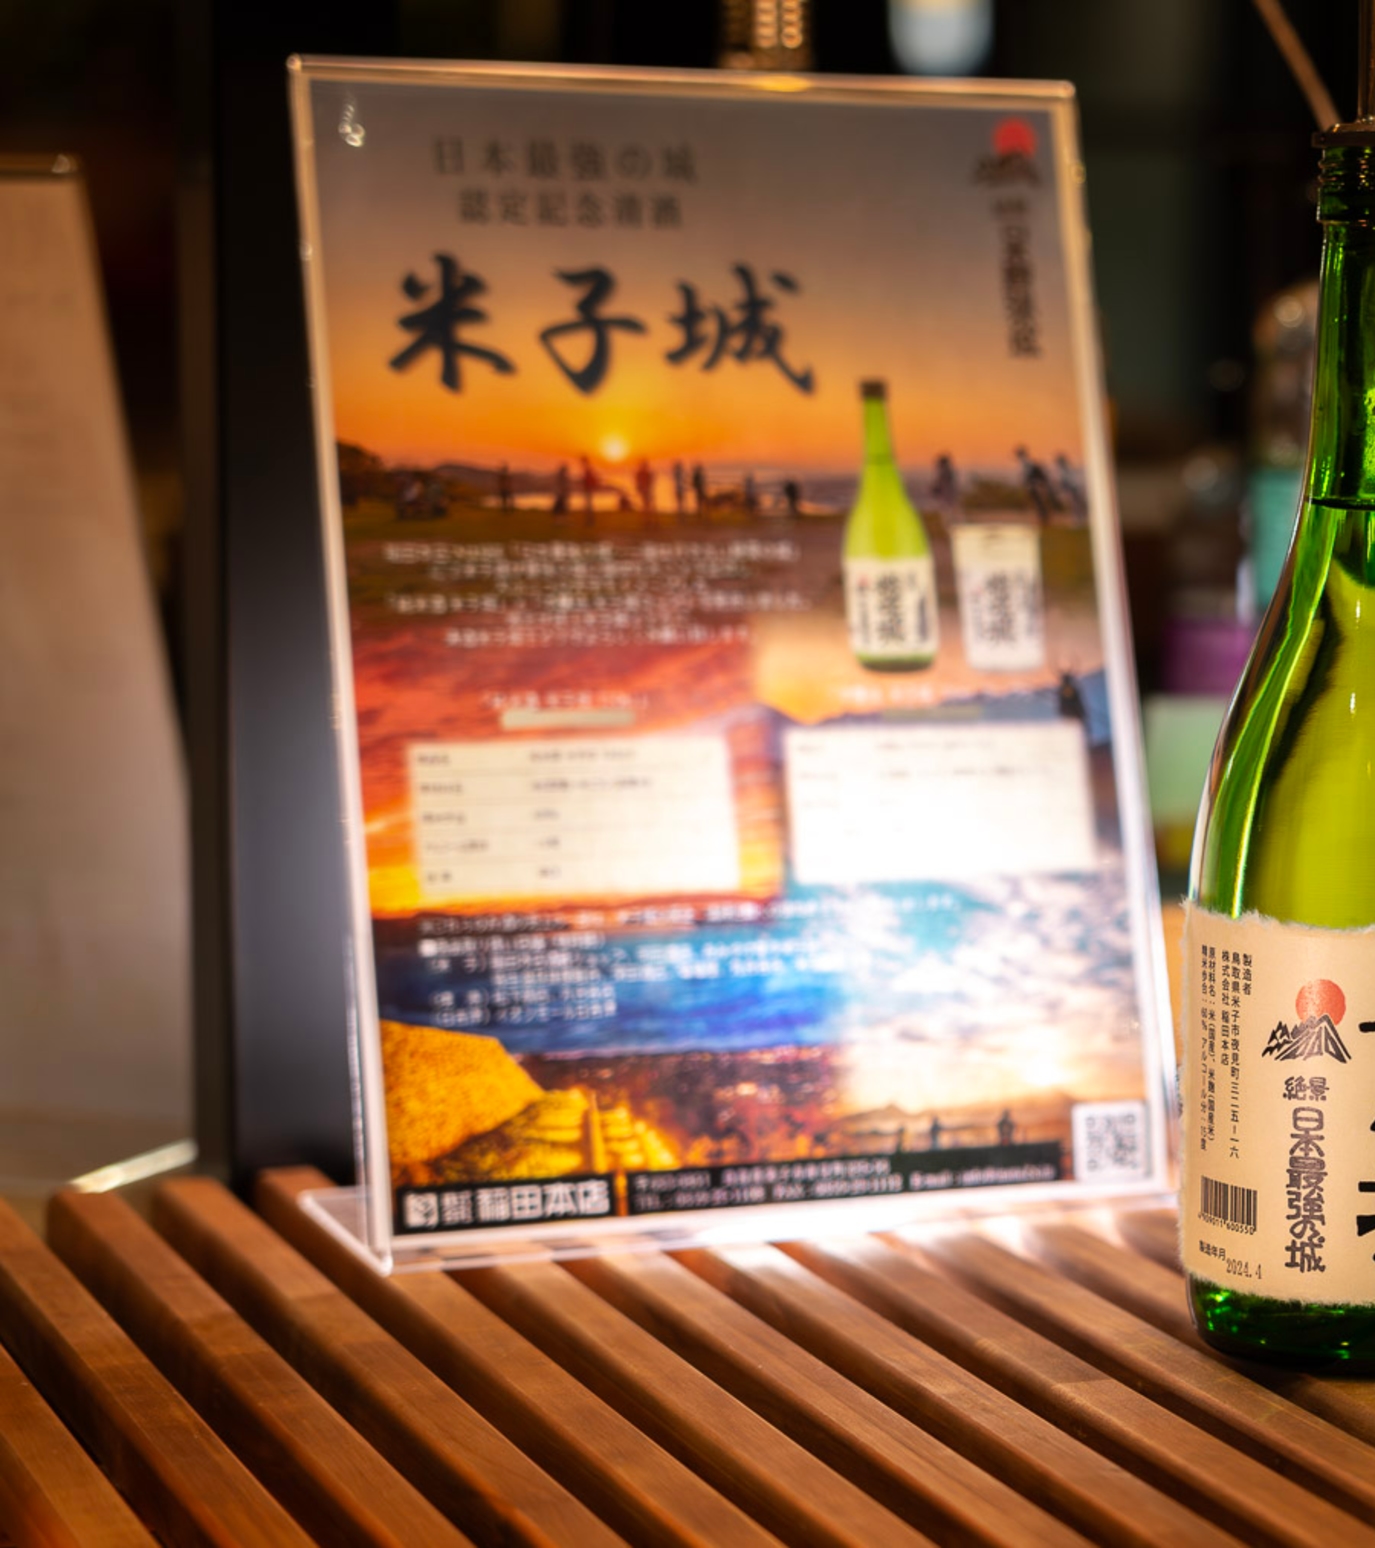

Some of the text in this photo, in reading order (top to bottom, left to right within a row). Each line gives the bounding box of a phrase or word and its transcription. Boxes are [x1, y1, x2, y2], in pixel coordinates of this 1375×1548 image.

[387, 251, 818, 396] 米子城
[1242, 952, 1253, 996] 製造者
[1282, 1075, 1331, 1102] 絶景
[1284, 1106, 1327, 1274] 日本最強の城
